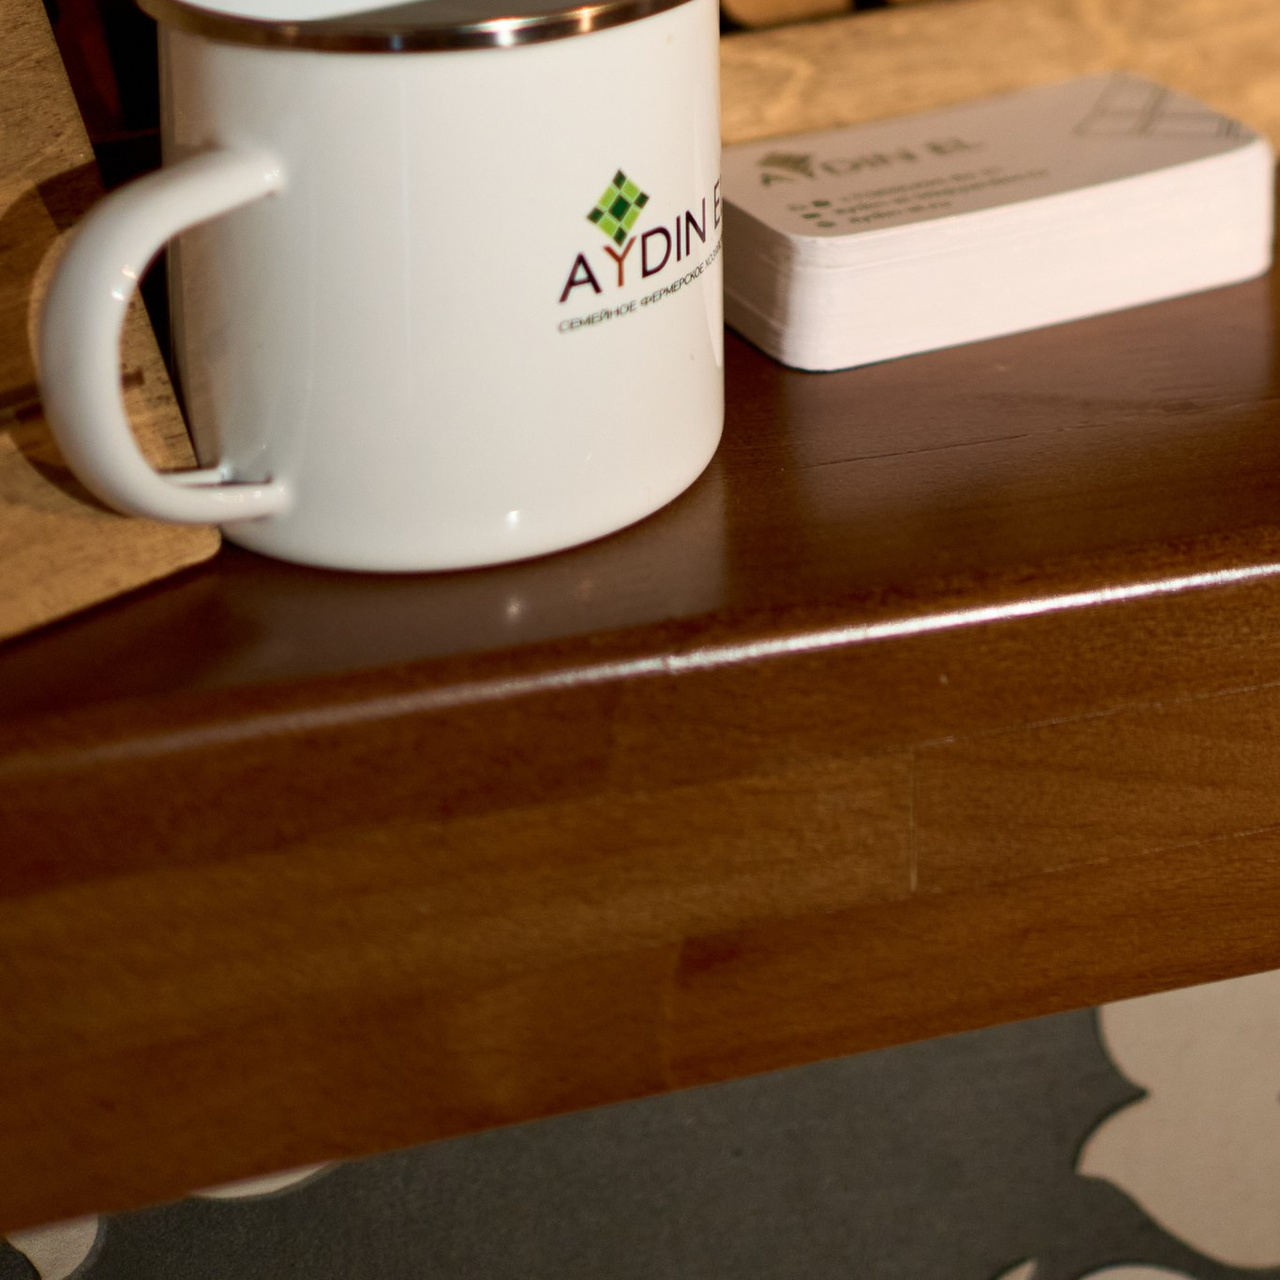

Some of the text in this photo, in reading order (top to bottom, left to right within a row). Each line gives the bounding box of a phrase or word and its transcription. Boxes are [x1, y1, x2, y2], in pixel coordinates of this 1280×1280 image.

[559, 196, 707, 304] AYDIN
[558, 300, 638, 334] СЕМЕЙНОЕ
[640, 262, 705, 307] ФЕРМЕРСКОЕ
